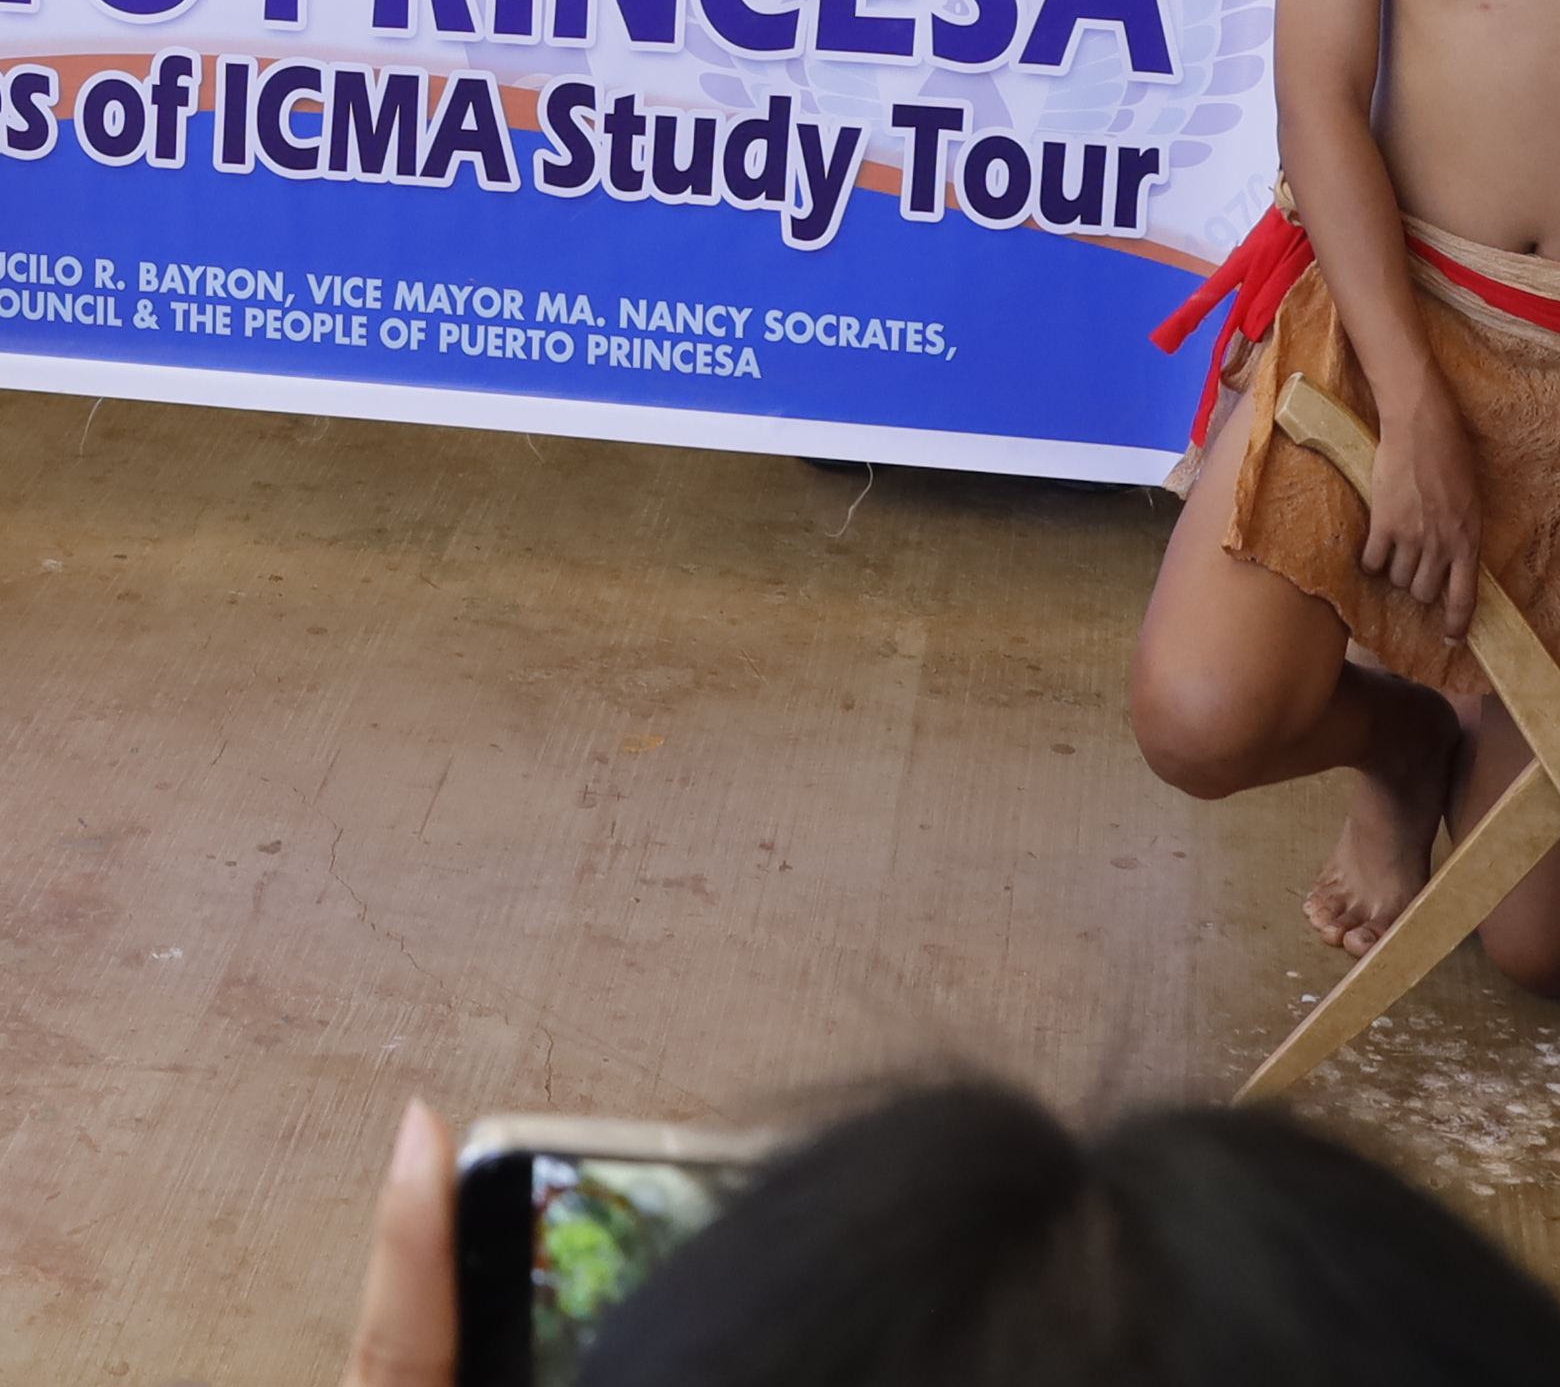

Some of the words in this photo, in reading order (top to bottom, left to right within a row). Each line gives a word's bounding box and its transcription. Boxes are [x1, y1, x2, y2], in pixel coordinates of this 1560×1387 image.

[82, 54, 193, 160] of
[223, 62, 510, 183] ICMA
[541, 82, 861, 241] Study
[892, 104, 1160, 229] Tour
[93, 258, 126, 290] R.
[139, 261, 296, 309] BAYRON,
[306, 273, 383, 310] VICE
[393, 280, 525, 321] MAYOR
[535, 291, 607, 328] MA.
[618, 297, 754, 339] NANCY
[763, 309, 958, 361] SOCRATES,
[132, 298, 160, 330] &
[170, 301, 232, 335] THE
[243, 306, 368, 346] PEOPLE
[379, 317, 428, 351] OF
[438, 323, 575, 363] PUERTO
[587, 333, 763, 379] PRINCESA
